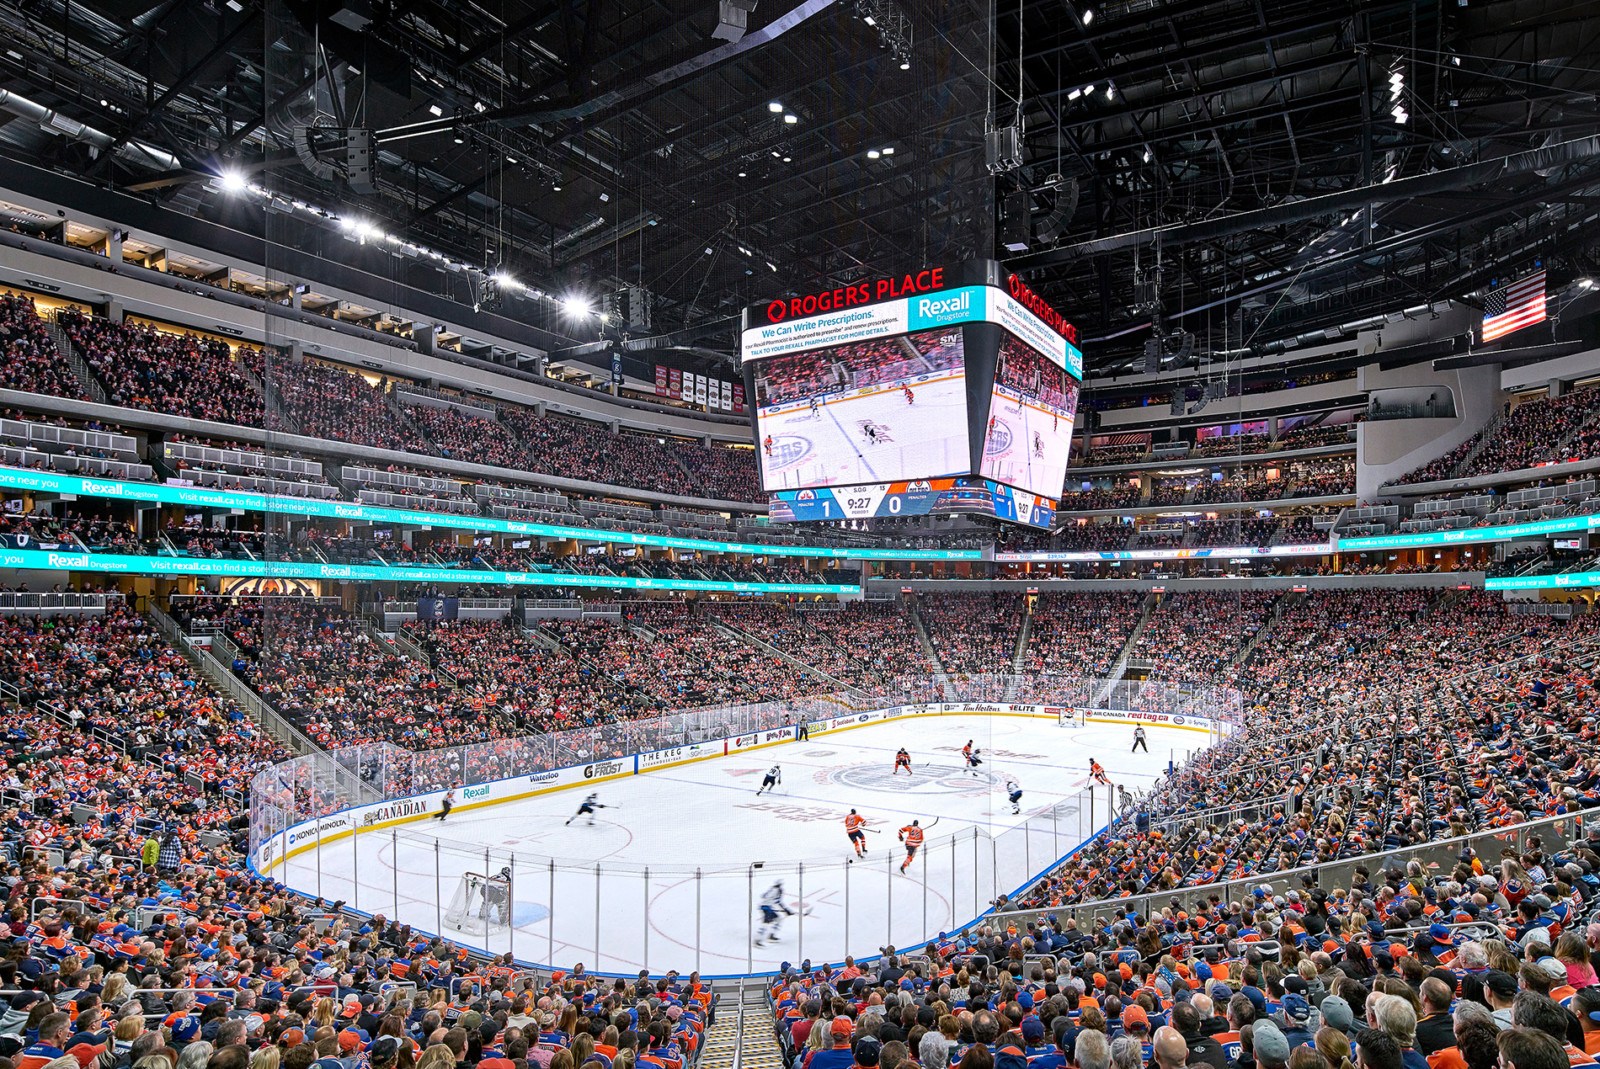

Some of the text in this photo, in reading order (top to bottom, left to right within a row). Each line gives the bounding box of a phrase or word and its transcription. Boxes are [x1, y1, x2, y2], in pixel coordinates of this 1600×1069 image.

[790, 268, 943, 317] ROGERS PLACE
[919, 292, 969, 318] Rexall
[937, 311, 969, 322] Drugstore
[1020, 283, 1055, 325] ROGERS
[1055, 312, 1077, 345] PLACE
[762, 329, 775, 338] We
[776, 326, 792, 336] Can
[794, 322, 816, 333] Write
[771, 345, 785, 353] YOUR
[785, 342, 804, 350] REXALL
[804, 335, 837, 346] PHARMACIST
[849, 331, 866, 339] MORE
[17, 476, 39, 485] near
[42, 479, 59, 489] you
[82, 480, 159, 498] Rexall Drugstore
[179, 492, 198, 501] Visit
[199, 495, 234, 504] rexall.ca
[246, 498, 261, 507] find
[268, 501, 288, 509] store
[306, 505, 320, 513] you
[822, 501, 830, 517] 1
[847, 498, 871, 509] 9:27
[888, 496, 901, 514] 0
[1008, 501, 1012, 517] 1
[335, 506, 363, 517] Rexall
[414, 515, 438, 523] rexall.ca
[507, 522, 526, 532] Rexall
[1443, 531, 1464, 541] Rexall
[4, 556, 24, 564] you
[48, 553, 128, 569] Rexall Drugstore
[150, 561, 171, 570] Visit
[172, 562, 211, 571] rexall.ca
[213, 564, 222, 572] to
[224, 564, 240, 572] find
[289, 567, 304, 576] you
[321, 566, 350, 577] Rexall
[405, 571, 431, 579] rexall.ca
[505, 573, 526, 583] Rexall
[962, 704, 974, 712] Tim
[975, 704, 1000, 712] Hortons
[643, 752, 659, 762] THE
[664, 748, 682, 757] KEG
[594, 763, 622, 777] FROST
[529, 772, 559, 783] Waterloo
[463, 785, 490, 799] Rexall
[377, 800, 427, 821] CANADIAN
[320, 819, 347, 832] MINOLTA
